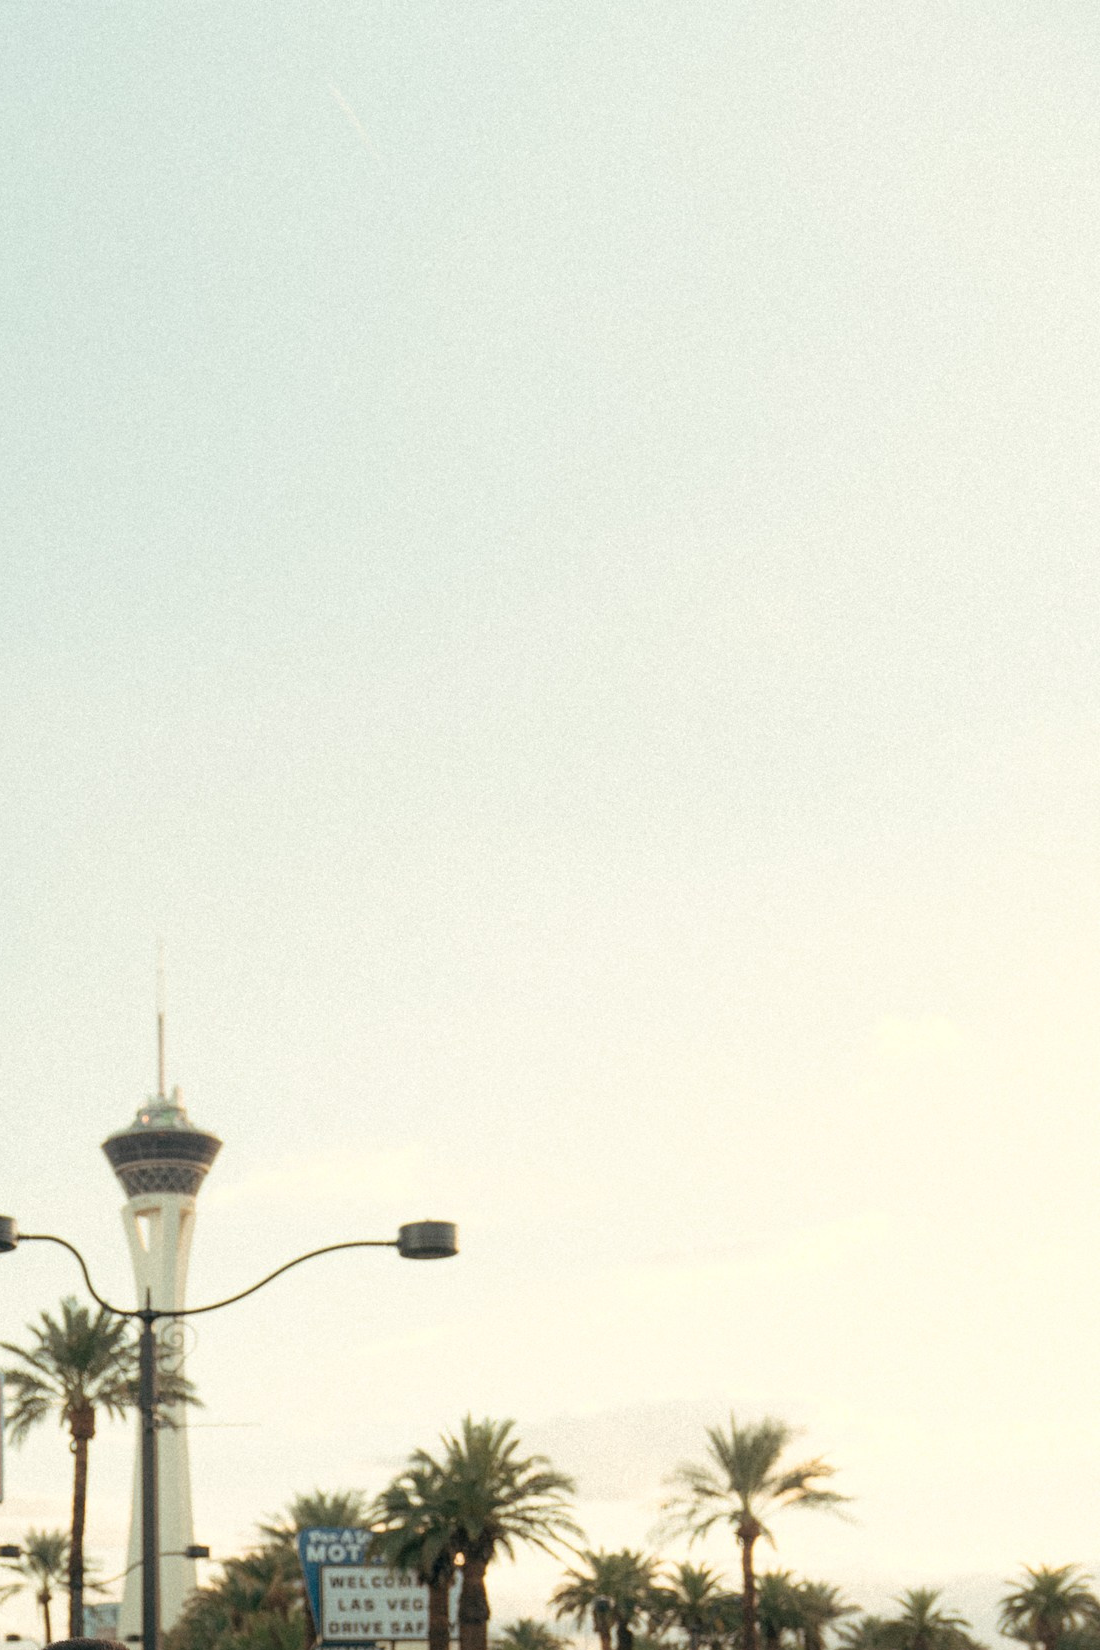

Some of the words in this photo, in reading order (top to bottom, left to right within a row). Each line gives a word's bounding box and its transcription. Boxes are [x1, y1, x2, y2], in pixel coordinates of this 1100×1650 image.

[306, 1543, 362, 1563] MOT
[337, 1598, 376, 1612] LAS
[386, 1598, 424, 1612] VEG
[328, 1621, 383, 1635] DRIVE
